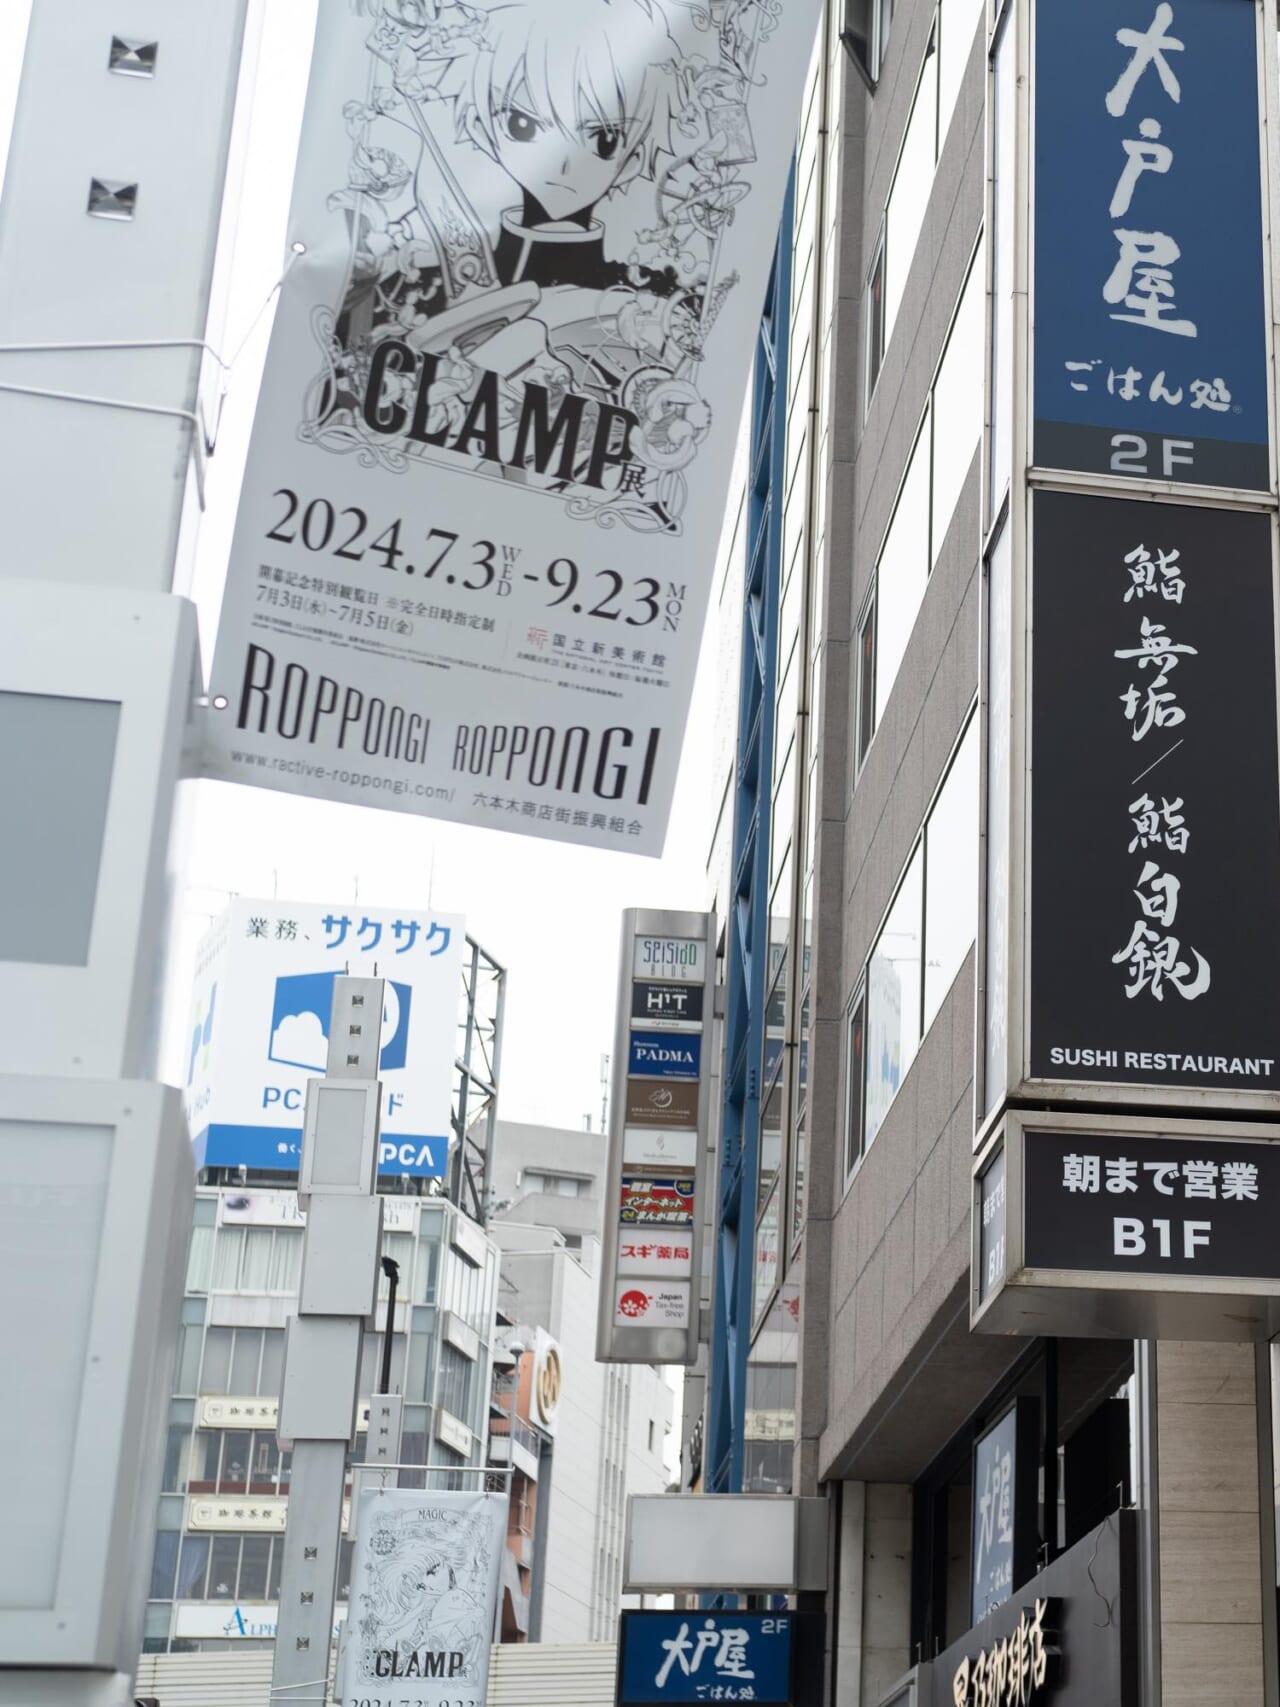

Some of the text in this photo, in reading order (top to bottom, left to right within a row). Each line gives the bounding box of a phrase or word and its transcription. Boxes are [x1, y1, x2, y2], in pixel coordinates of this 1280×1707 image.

[1103, 2, 1197, 337] 大戸屋
[1065, 359, 1232, 413] ごはん処
[1110, 434, 1194, 476] 2F
[266, 489, 498, 591] 2024.7.3
[496, 544, 523, 598] WED
[662, 581, 687, 633] MON
[553, 633, 667, 667] 国立新美術館
[470, 791, 644, 837] 六本木商店街振興組合
[636, 1048, 694, 1063] PADMA
[1050, 1046, 1275, 1078] SUSHI RESTAURANT
[378, 1142, 435, 1168] PCA
[1062, 1153, 1260, 1202] 朝まで営業
[620, 1243, 690, 1260] スギ薬局
[1112, 1215, 1212, 1260] B1F
[658, 1292, 683, 1301] Japan
[418, 1508, 449, 1521] MAGIC
[655, 1618, 788, 1688] 大戸屋 2F
[696, 1683, 756, 1700] ごはん処
